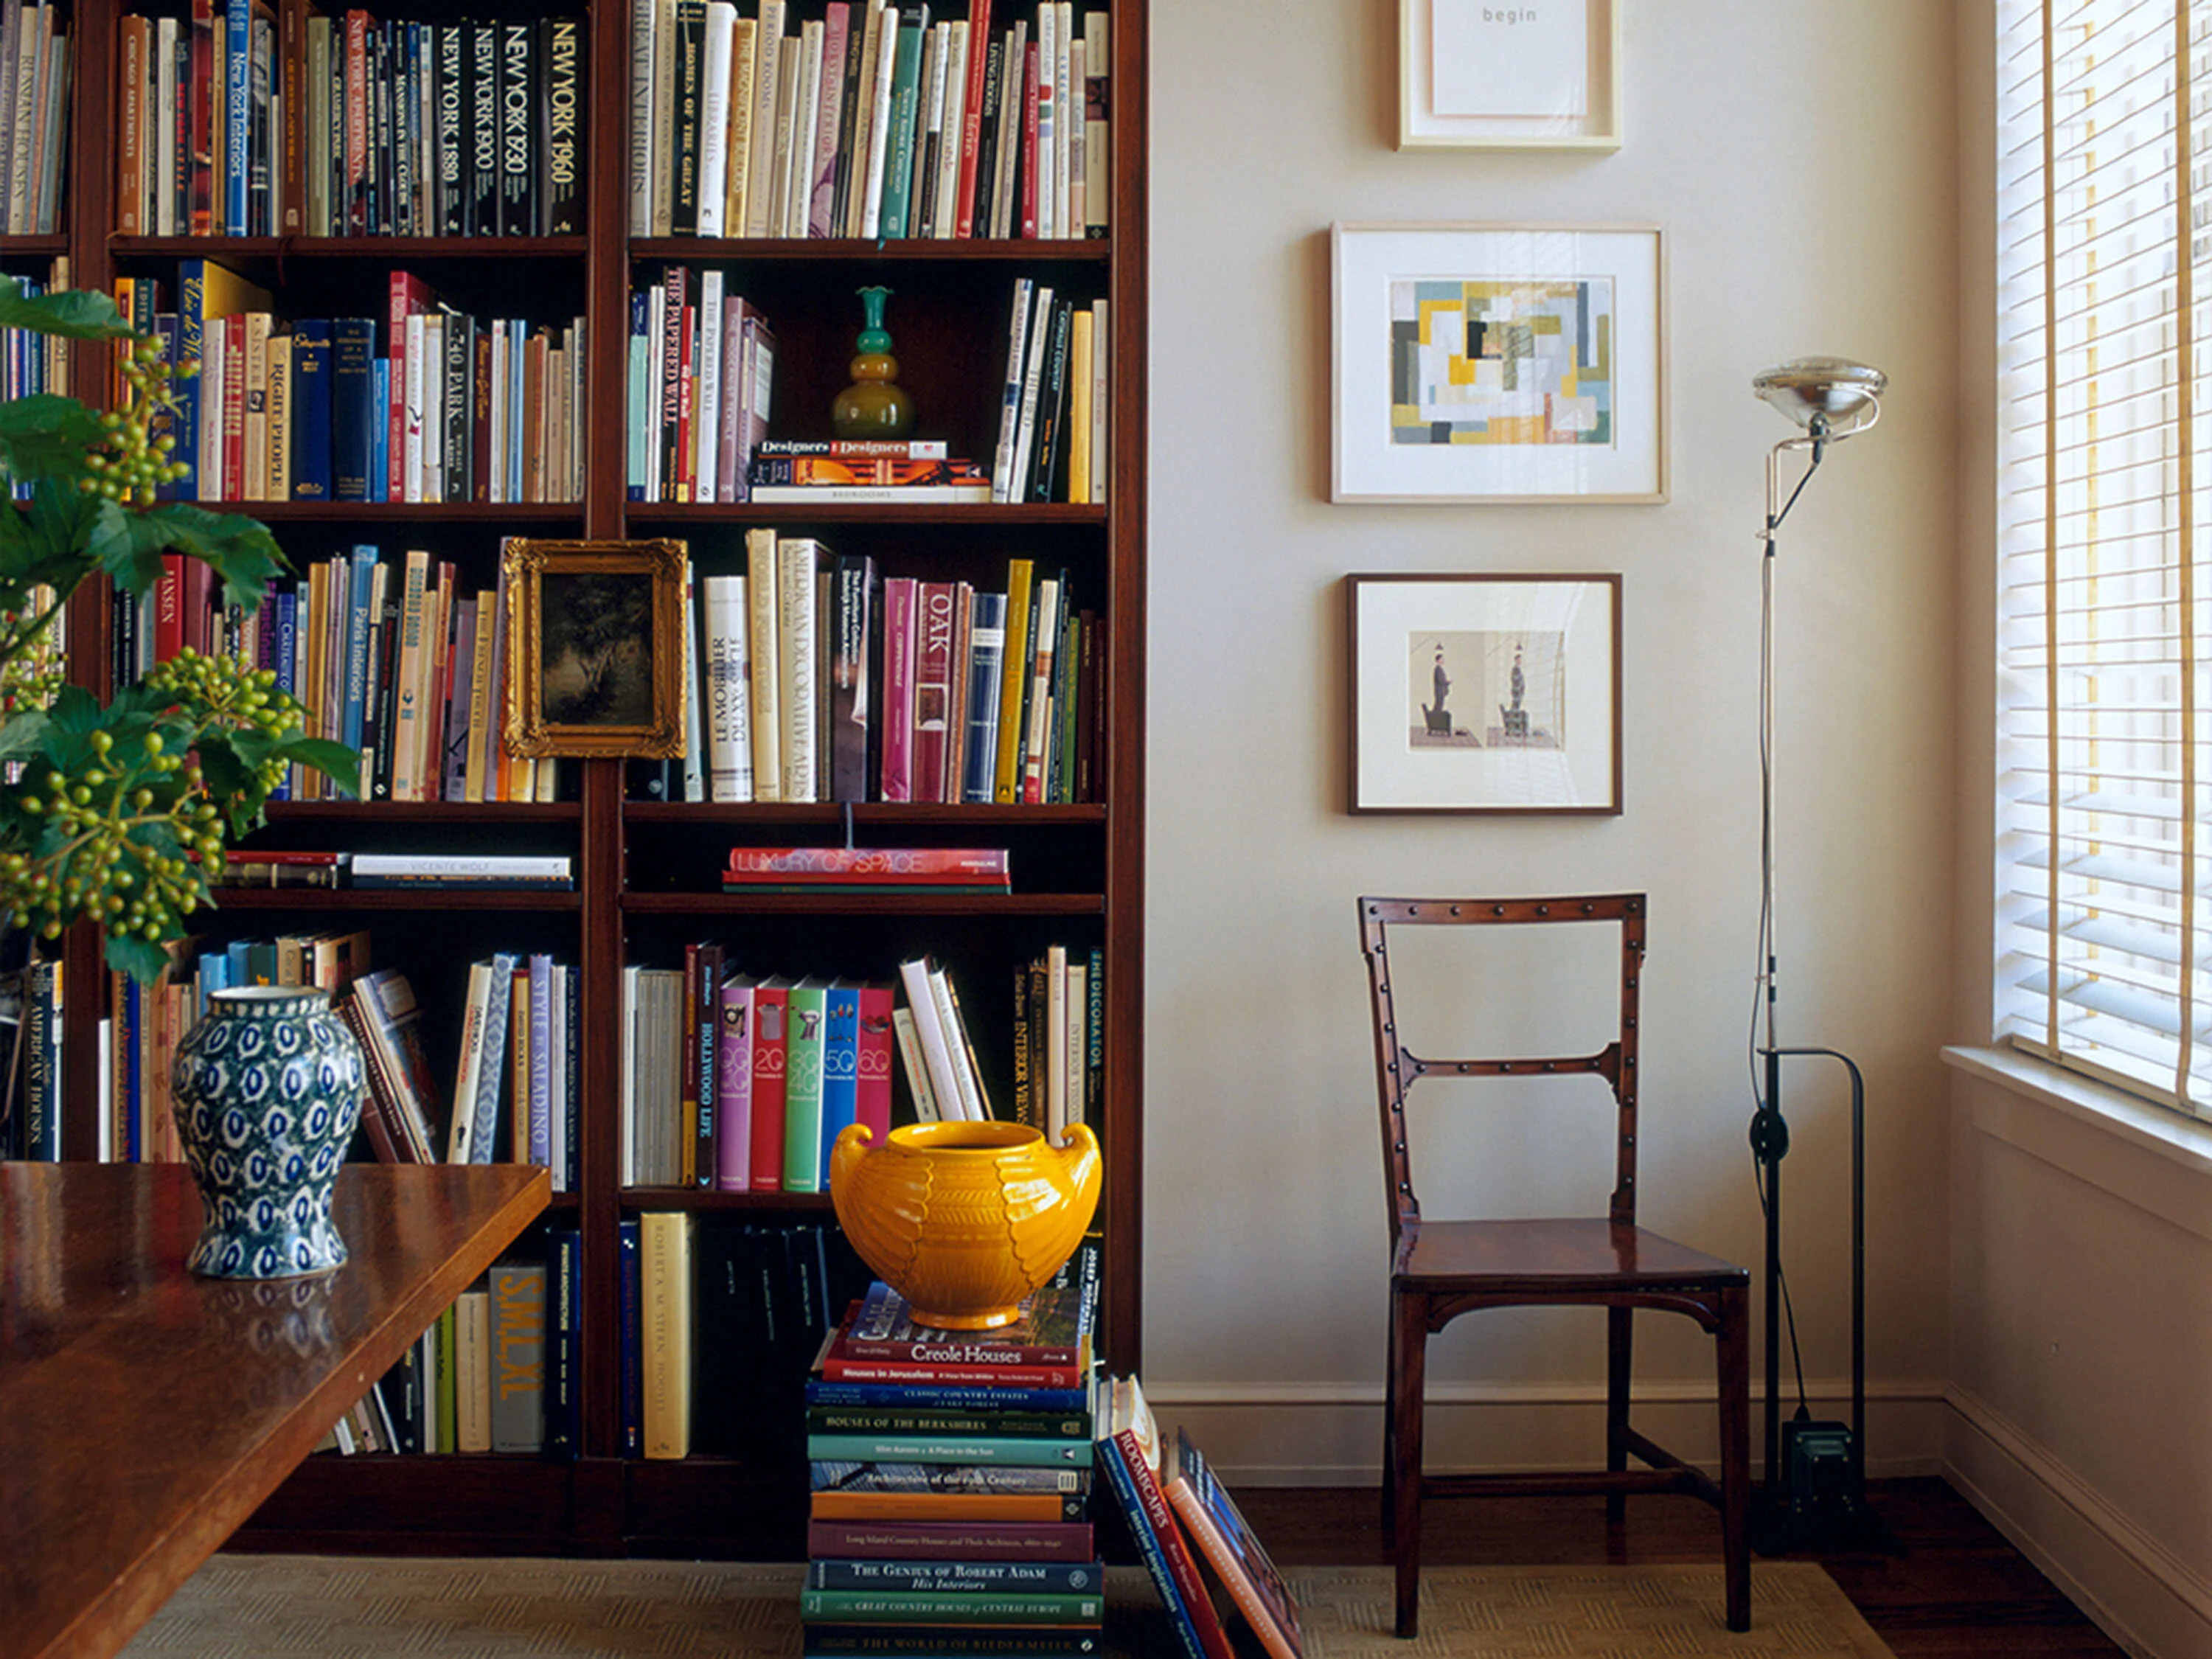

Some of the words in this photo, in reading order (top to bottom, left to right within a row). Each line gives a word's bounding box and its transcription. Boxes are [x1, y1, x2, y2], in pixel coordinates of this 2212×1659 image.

[350, 18, 363, 51] NEW
[633, 1, 650, 69] GREAT
[765, 6, 778, 57] PERIOD
[1483, 7, 1537, 25] begin
[127, 35, 136, 84] CHICAGO
[231, 52, 246, 84] New
[350, 53, 363, 88] YORK
[442, 27, 460, 77] NEW
[475, 27, 494, 74] NEW
[505, 26, 527, 78] NEW
[552, 23, 576, 75] NEW
[684, 42, 697, 94] HOMES
[740, 36, 751, 60] THE
[827, 31, 841, 73] HORST
[17, 55, 35, 124] RUSSIAN
[231, 86, 245, 118] York
[395, 74, 406, 126] MANSIONS
[474, 76, 494, 128] YORK
[505, 80, 527, 133] YORK
[552, 77, 575, 136] YORK
[683, 97, 695, 119] OF
[734, 63, 750, 139] MAGNIFICENT
[761, 62, 774, 110] ROOMS
[125, 88, 136, 158] APARTMENTS
[442, 80, 460, 138] YORK
[703, 91, 720, 164] LIBRARIES
[820, 86, 838, 163] INTERIORS
[230, 118, 246, 178] Interiors
[352, 96, 364, 181] APARTMENTS
[397, 129, 406, 140] IN
[397, 144, 407, 162] THE
[475, 128, 494, 170] 1900
[505, 134, 527, 173] 1930
[632, 77, 649, 193] INTERIORS
[682, 122, 694, 152] THE
[965, 114, 979, 158] Interiors
[13, 130, 30, 198] HOUSES
[442, 142, 459, 182] 1880
[551, 139, 574, 183] 1960
[681, 156, 692, 206] GREAT
[397, 164, 408, 204] CLOUDS
[184, 277, 204, 311] Elsie
[667, 267, 681, 304] THE
[184, 315, 201, 329] de
[706, 301, 717, 322] THE
[251, 330, 264, 383] SISTER
[448, 334, 465, 364] 740
[664, 305, 681, 380] PAPERED
[704, 328, 716, 380] PAPERED
[270, 363, 285, 419] RIGHT
[448, 372, 464, 420] PARK
[663, 382, 678, 426] WALL
[681, 397, 689, 419] Wall
[703, 383, 713, 413] WALL
[271, 424, 285, 488] PEOPLE
[761, 440, 830, 456] Designers
[840, 441, 908, 456] Designers
[161, 570, 175, 624] JANSEN
[794, 545, 810, 632] AMERICAN
[852, 570, 860, 585] The
[353, 608, 367, 641] Paris
[852, 587, 860, 623] Furniture
[928, 594, 952, 653] OAK
[851, 625, 859, 665] Collection
[350, 644, 366, 703] Interiors
[713, 638, 728, 721] MOBILIER
[793, 638, 809, 748] DECORATIVE
[714, 722, 728, 742] LE
[732, 717, 746, 742] DU
[793, 750, 809, 798] ARTS
[411, 860, 459, 871] VICENTE
[467, 860, 490, 871] WOLF
[737, 852, 816, 872] LUXURY
[819, 852, 845, 872] OF
[855, 852, 923, 873] SPACE
[1091, 953, 1102, 979] THE
[532, 979, 546, 1029] STYLE
[1091, 981, 1102, 1068] DECORATOR
[31, 1004, 44, 1080] AMERICAN
[701, 1023, 713, 1105] HOLLYWOOD
[1015, 1021, 1028, 1082] INTERIOR
[1070, 1023, 1081, 1077] INTERIOR
[30, 1085, 44, 1144] HOUSES
[532, 1052, 546, 1144] SALADINO
[1016, 1084, 1028, 1124] VIEWS
[700, 1108, 712, 1138] LIFE
[655, 1225, 667, 1277] ROBERT
[1086, 1248, 1098, 1281] JOSEF
[495, 1275, 545, 1401] S,M,L,XL
[655, 1313, 667, 1353] STERN
[911, 1343, 962, 1363] Creole
[964, 1344, 1021, 1364] Houses
[655, 1363, 667, 1413] HOUSES
[843, 1368, 874, 1378] Houses
[877, 1368, 887, 1379] in
[888, 1369, 934, 1380] Jerusalem
[904, 1390, 940, 1399] CLASSIC
[943, 1391, 987, 1399] COUNTRY
[989, 1391, 1029, 1400] ESTATES
[825, 1416, 871, 1427] HOUSES
[874, 1417, 889, 1428] OF
[894, 1418, 913, 1428] THE
[917, 1418, 987, 1430] BERKSHIRES
[875, 1444, 893, 1454] Slim
[978, 1447, 994, 1456] Sun
[866, 1472, 928, 1484] Architecture
[929, 1472, 942, 1485] of
[943, 1472, 959, 1485] the
[990, 1474, 1027, 1487] Century
[1117, 1433, 1172, 1528] ROOMSCAPES
[846, 1534, 865, 1545] Long
[866, 1534, 888, 1545] Island
[888, 1536, 919, 1547] Country
[921, 1537, 946, 1546] Houses
[947, 1537, 962, 1546] and
[964, 1537, 983, 1547] Their
[1127, 1509, 1155, 1551] Interior
[1144, 1551, 1180, 1613] Inspirations
[850, 1564, 878, 1576] THE
[883, 1564, 930, 1577] GENIUS
[934, 1566, 950, 1577] OF
[954, 1565, 1004, 1578] ROBERT
[1008, 1566, 1046, 1579] ADAM
[911, 1578, 931, 1589] His
[935, 1578, 986, 1590] Interiors
[855, 1601, 886, 1611] GREAT
[888, 1602, 933, 1613] COUNTRY
[935, 1603, 970, 1613] HOUSES
[981, 1604, 1024, 1614] CENTRAL
[1026, 1604, 1061, 1615] EUROPE
[861, 1638, 889, 1649] THE
[894, 1638, 944, 1649] WORLD
[950, 1638, 967, 1649] OF
[973, 1638, 1072, 1651] BIEDERMEIER
